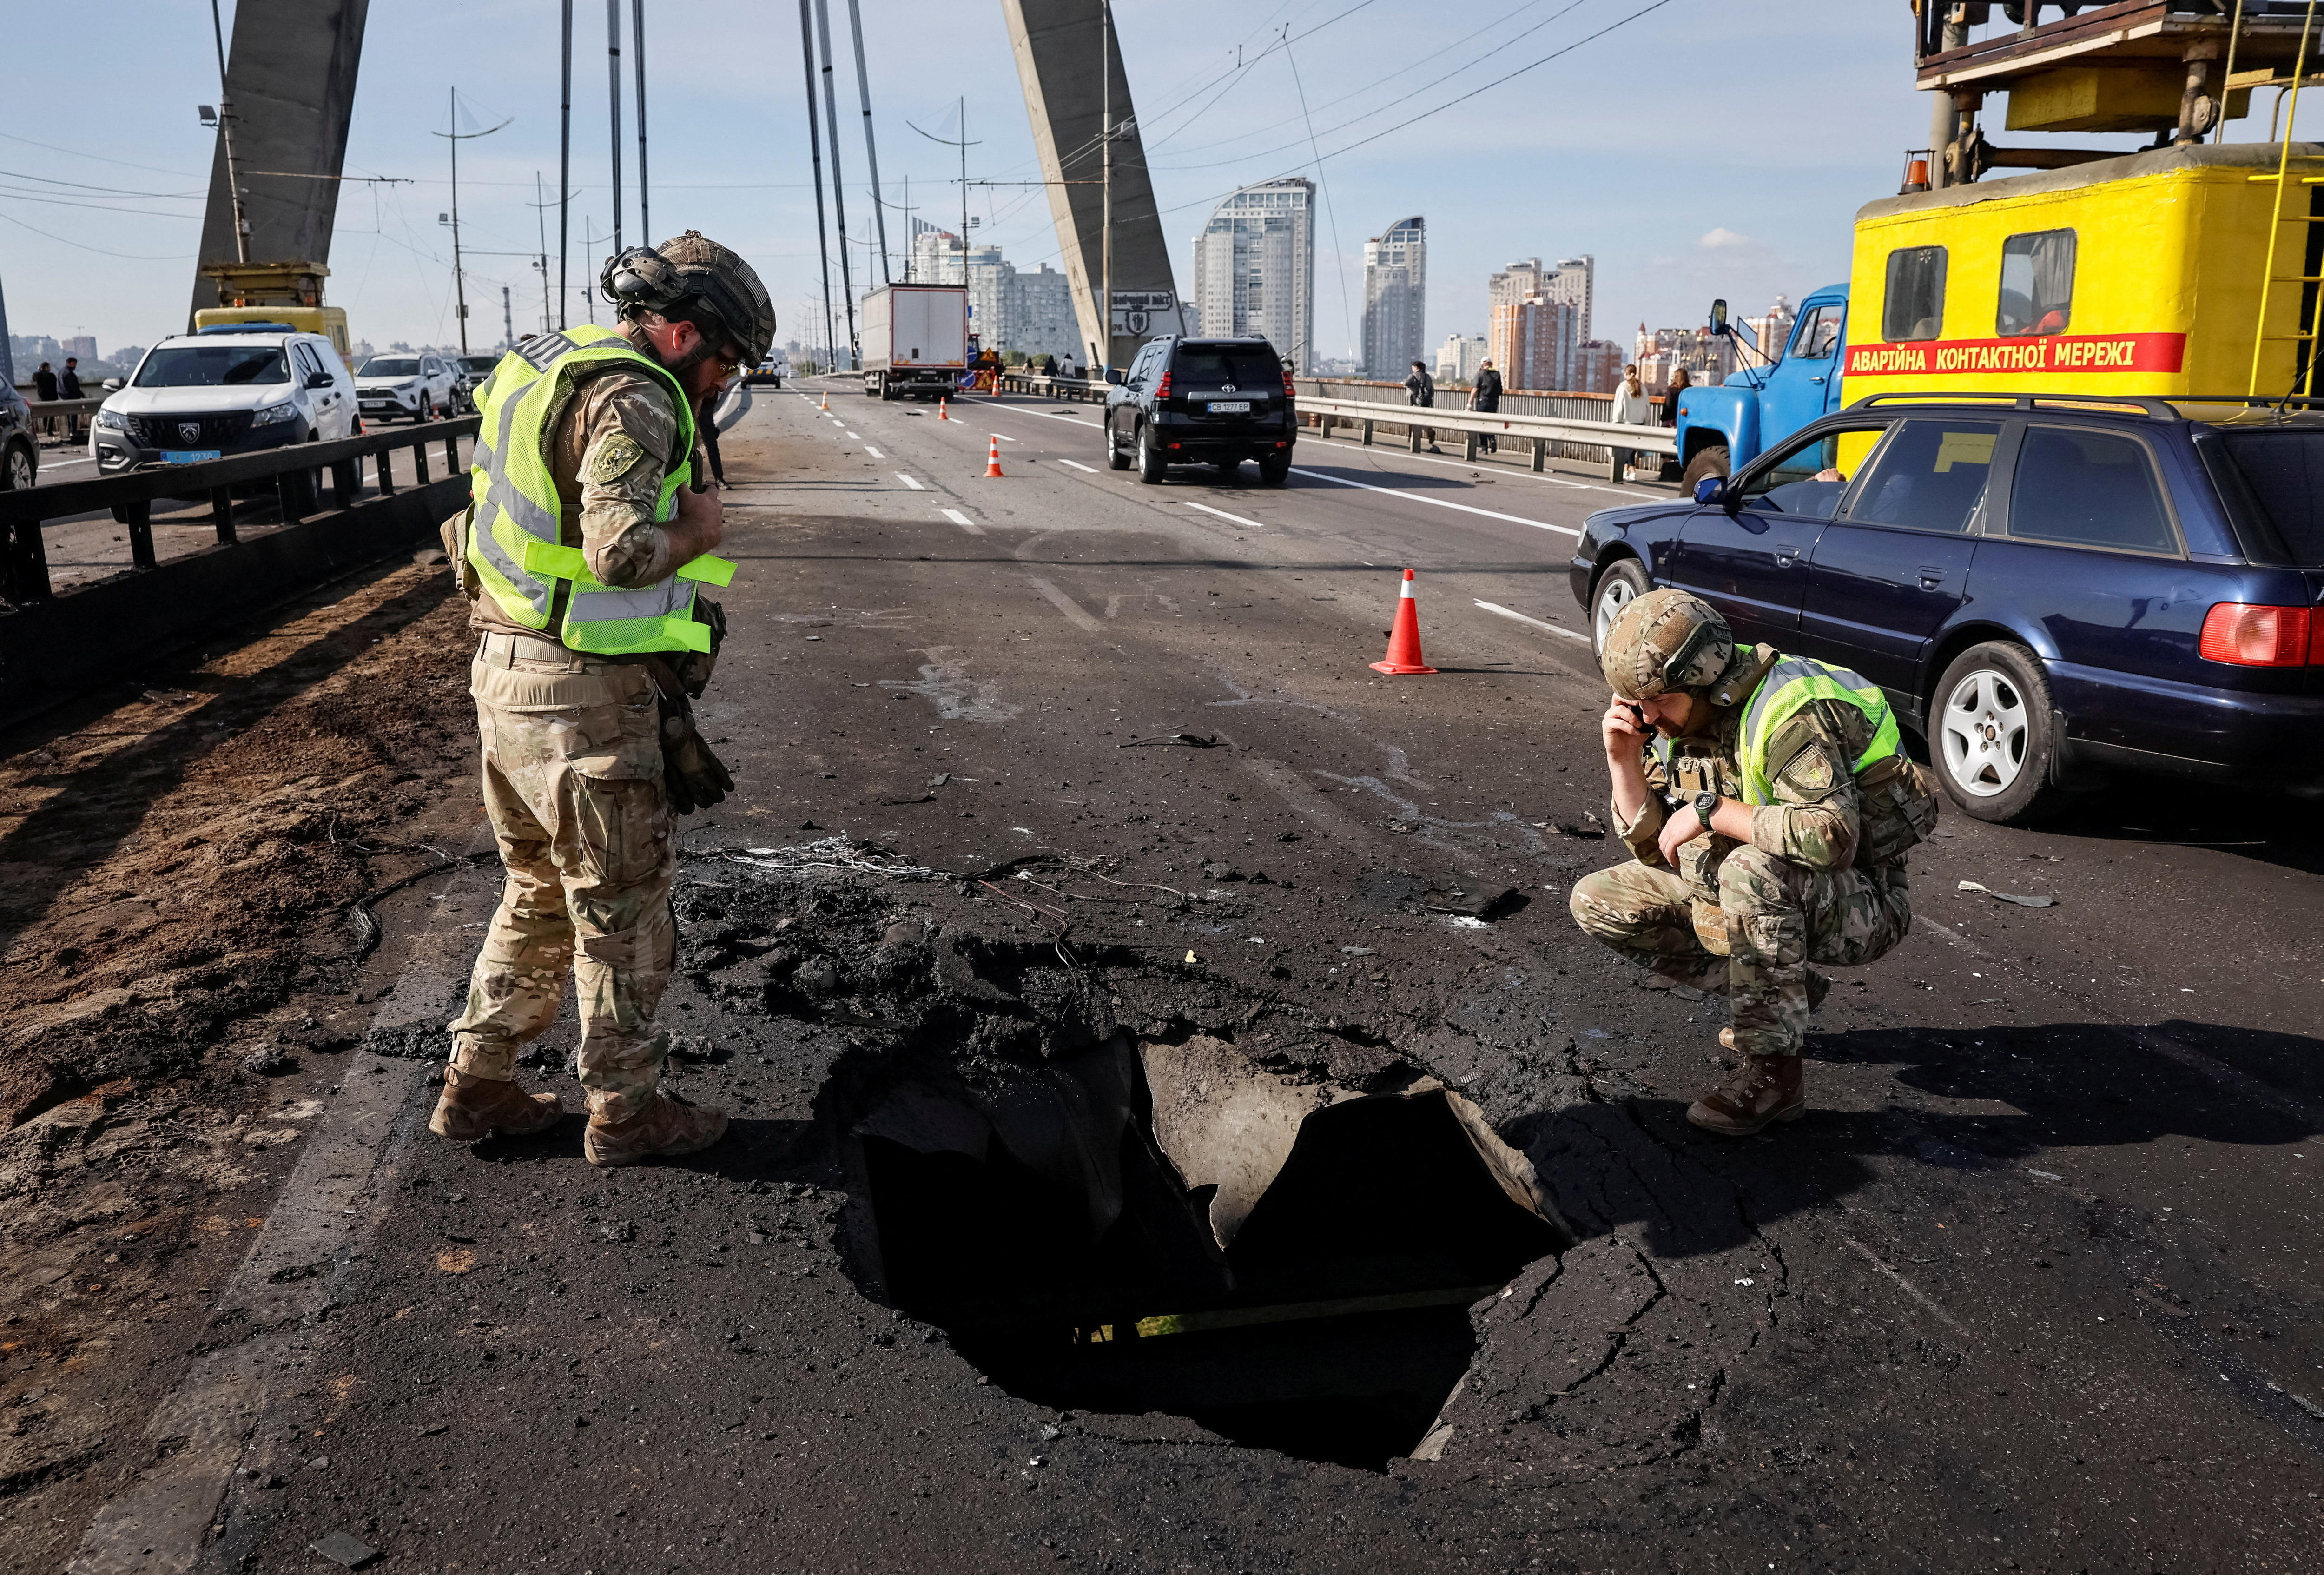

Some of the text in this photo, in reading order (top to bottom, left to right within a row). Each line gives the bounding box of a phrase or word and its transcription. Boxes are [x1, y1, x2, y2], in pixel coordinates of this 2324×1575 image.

[1851, 338, 2136, 371] АВАРІЙНА КОНТАКТНОЇ МЕРЕЖІ
[1785, 748, 1816, 774] ПОЛІЦІЯ
